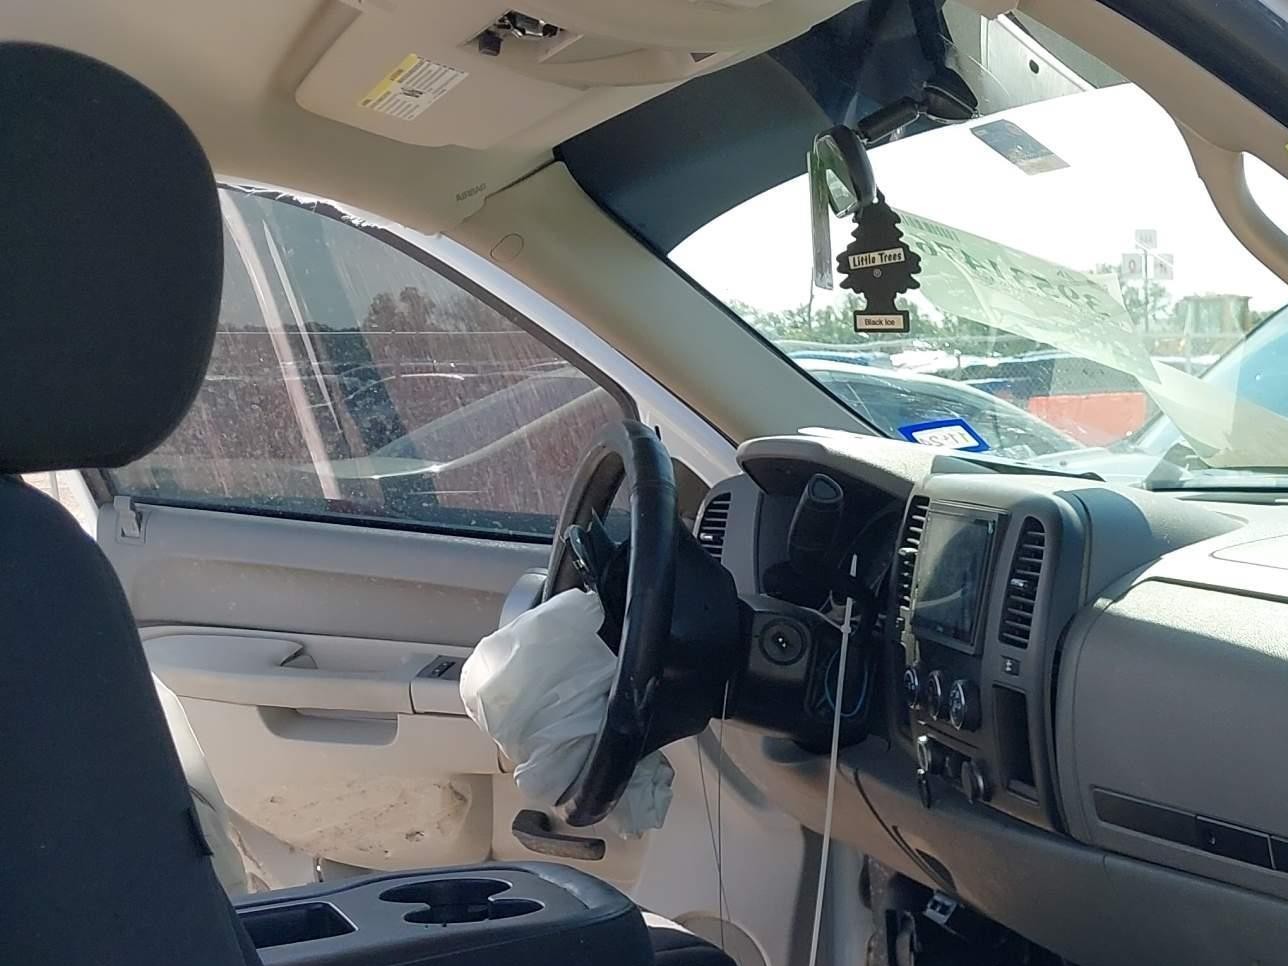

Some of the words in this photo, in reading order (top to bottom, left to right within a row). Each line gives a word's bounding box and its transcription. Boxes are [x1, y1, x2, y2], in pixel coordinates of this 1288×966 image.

[852, 254, 876, 268] Little
[878, 251, 902, 263] Trees
[864, 318, 883, 326] Black
[885, 318, 895, 326] Ice
